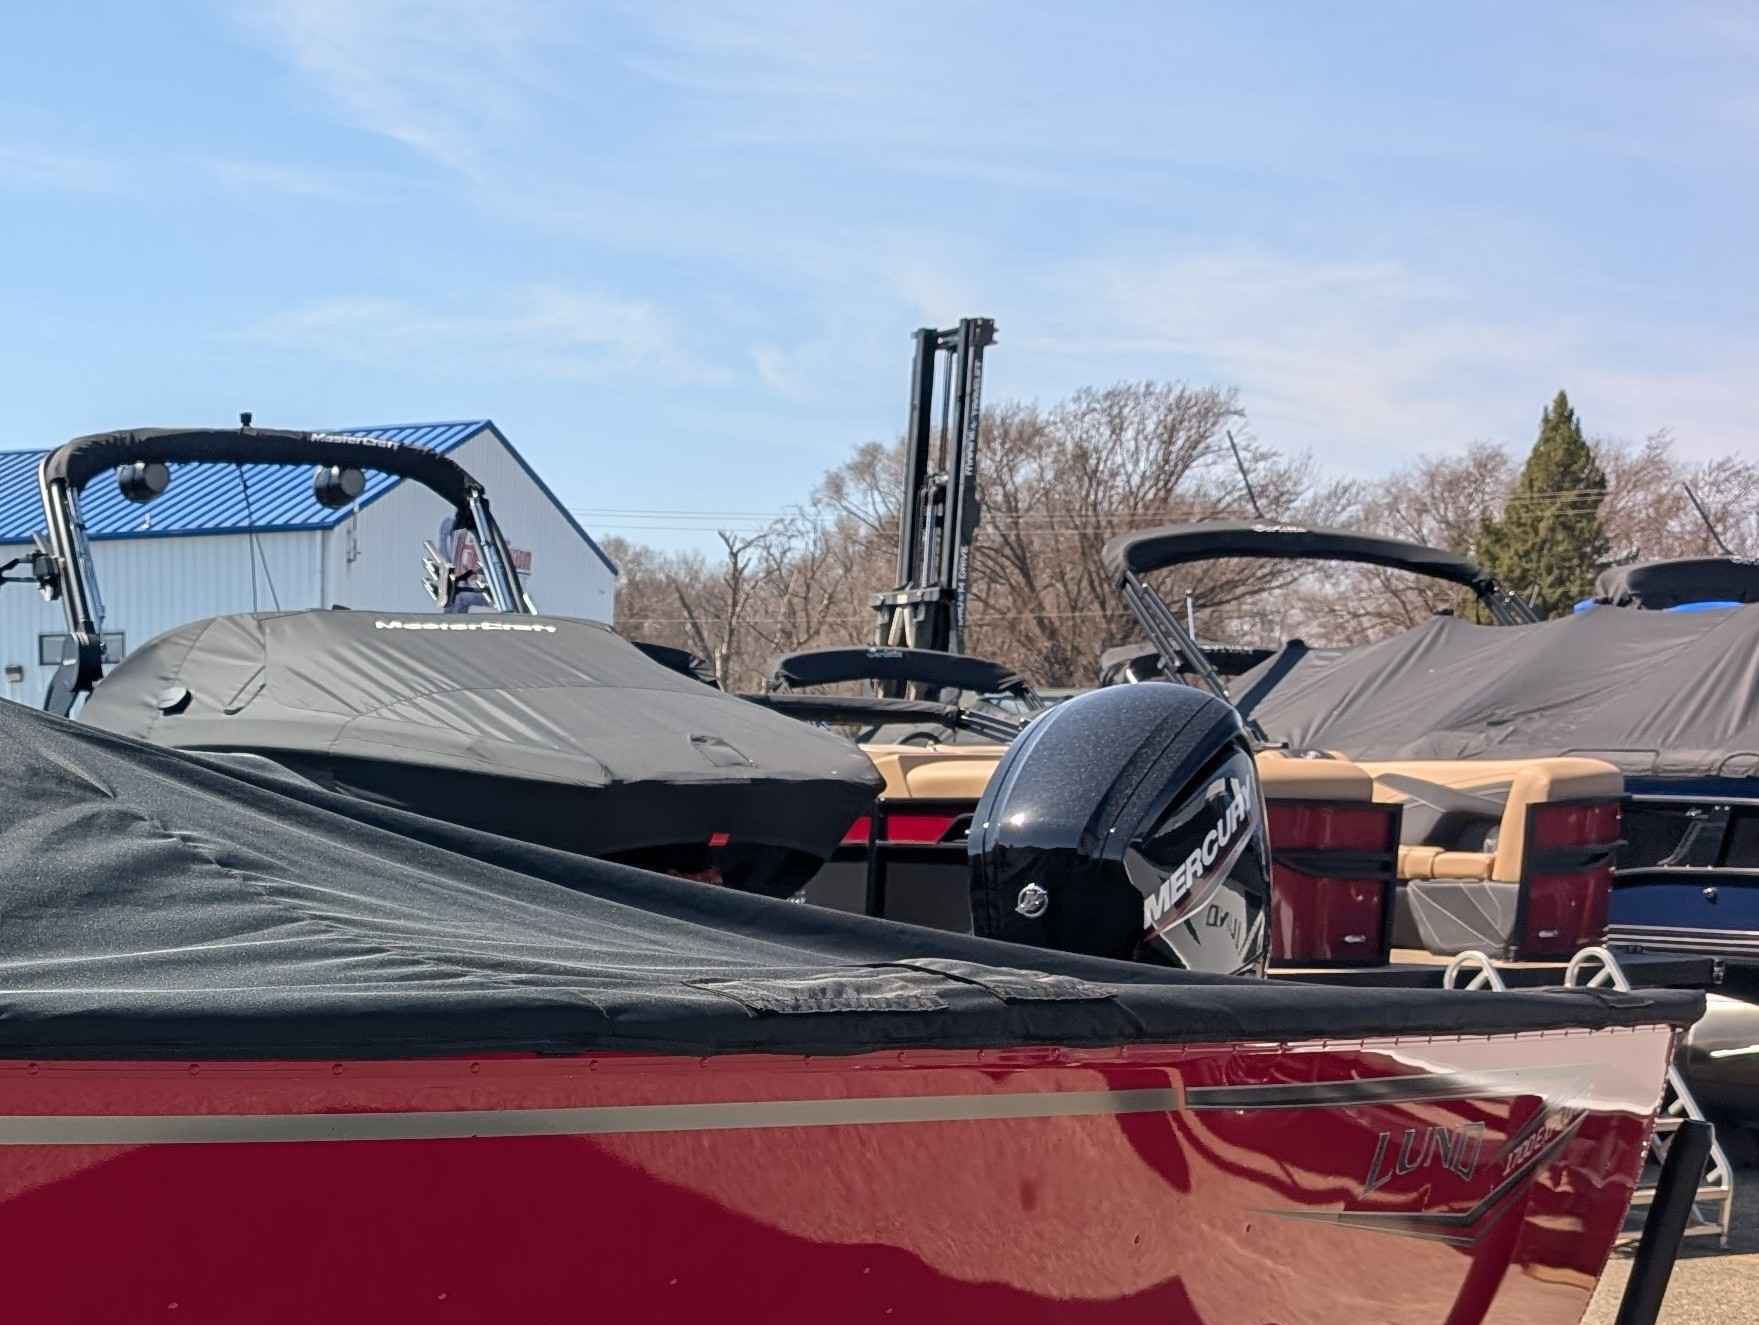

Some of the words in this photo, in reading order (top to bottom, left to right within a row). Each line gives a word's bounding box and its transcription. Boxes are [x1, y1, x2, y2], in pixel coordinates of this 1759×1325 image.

[375, 620, 557, 633] MasterCraft
[1144, 776, 1251, 930] MERCURY
[1357, 1121, 1485, 1200] LUND
